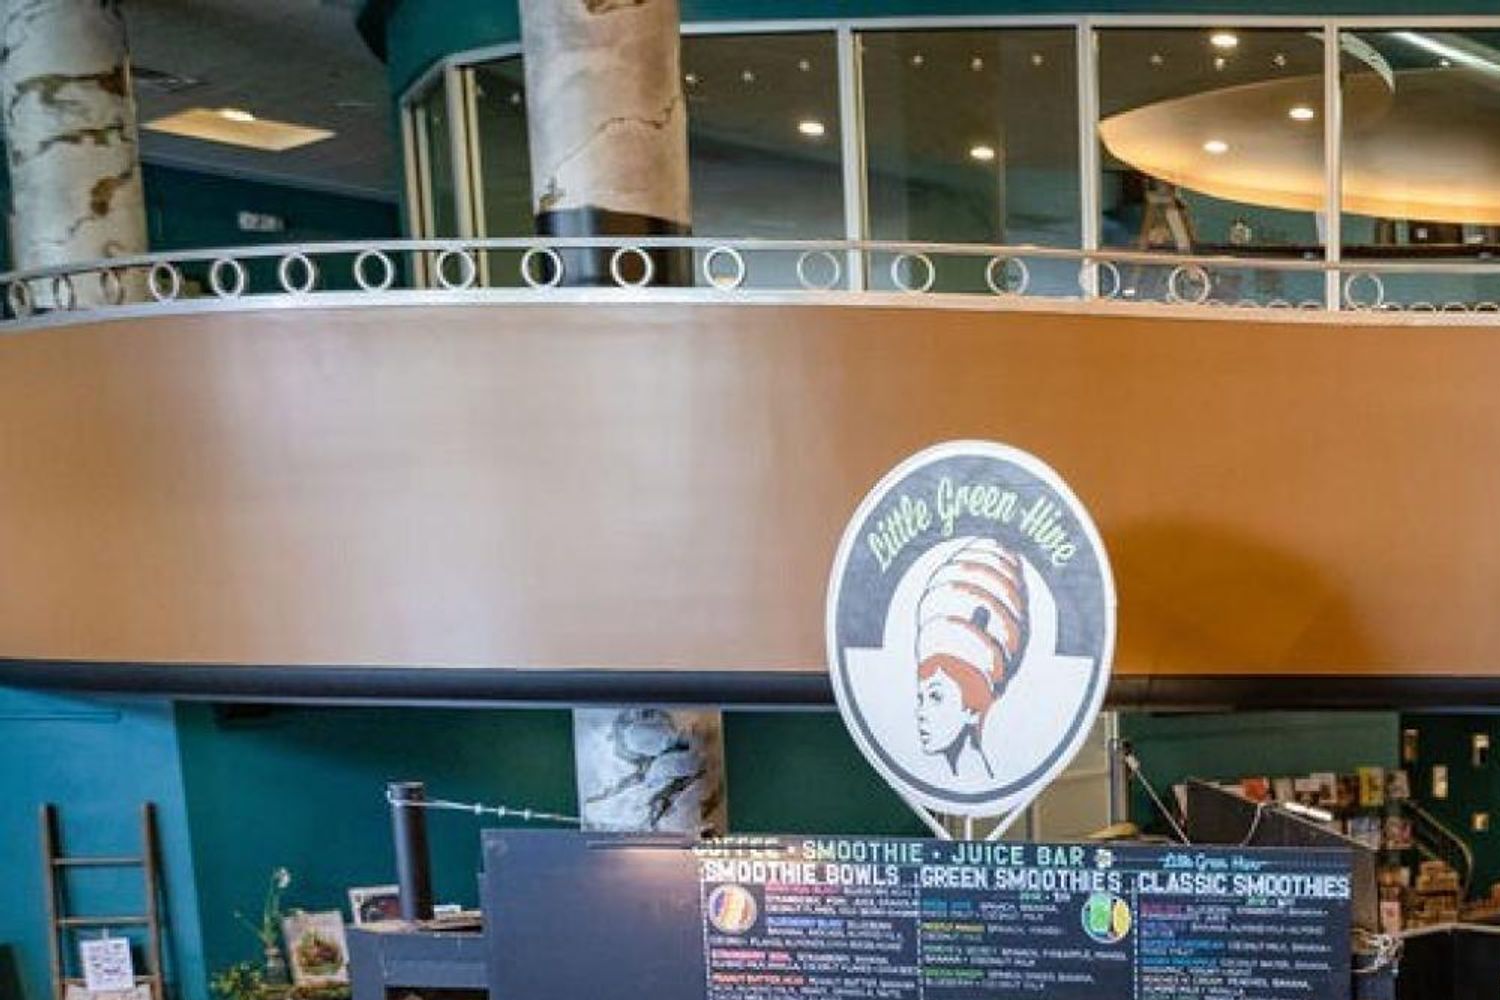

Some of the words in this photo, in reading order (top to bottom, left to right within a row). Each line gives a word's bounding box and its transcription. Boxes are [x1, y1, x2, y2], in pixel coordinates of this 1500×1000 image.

[867, 495, 932, 572] Little
[937, 477, 1018, 537] Green
[1020, 496, 1076, 566] Hive
[802, 840, 923, 862] SMOOTHIE
[951, 843, 1024, 866] JUICE
[1037, 846, 1085, 867] BAR
[703, 860, 817, 885] SMOOTHIE
[826, 863, 899, 885] BOWLS
[921, 866, 988, 888] GREEN
[995, 869, 1121, 893] SMOOTHIES
[1138, 872, 1227, 894] CLASSIC
[1232, 875, 1351, 898] SMOOTHIES
